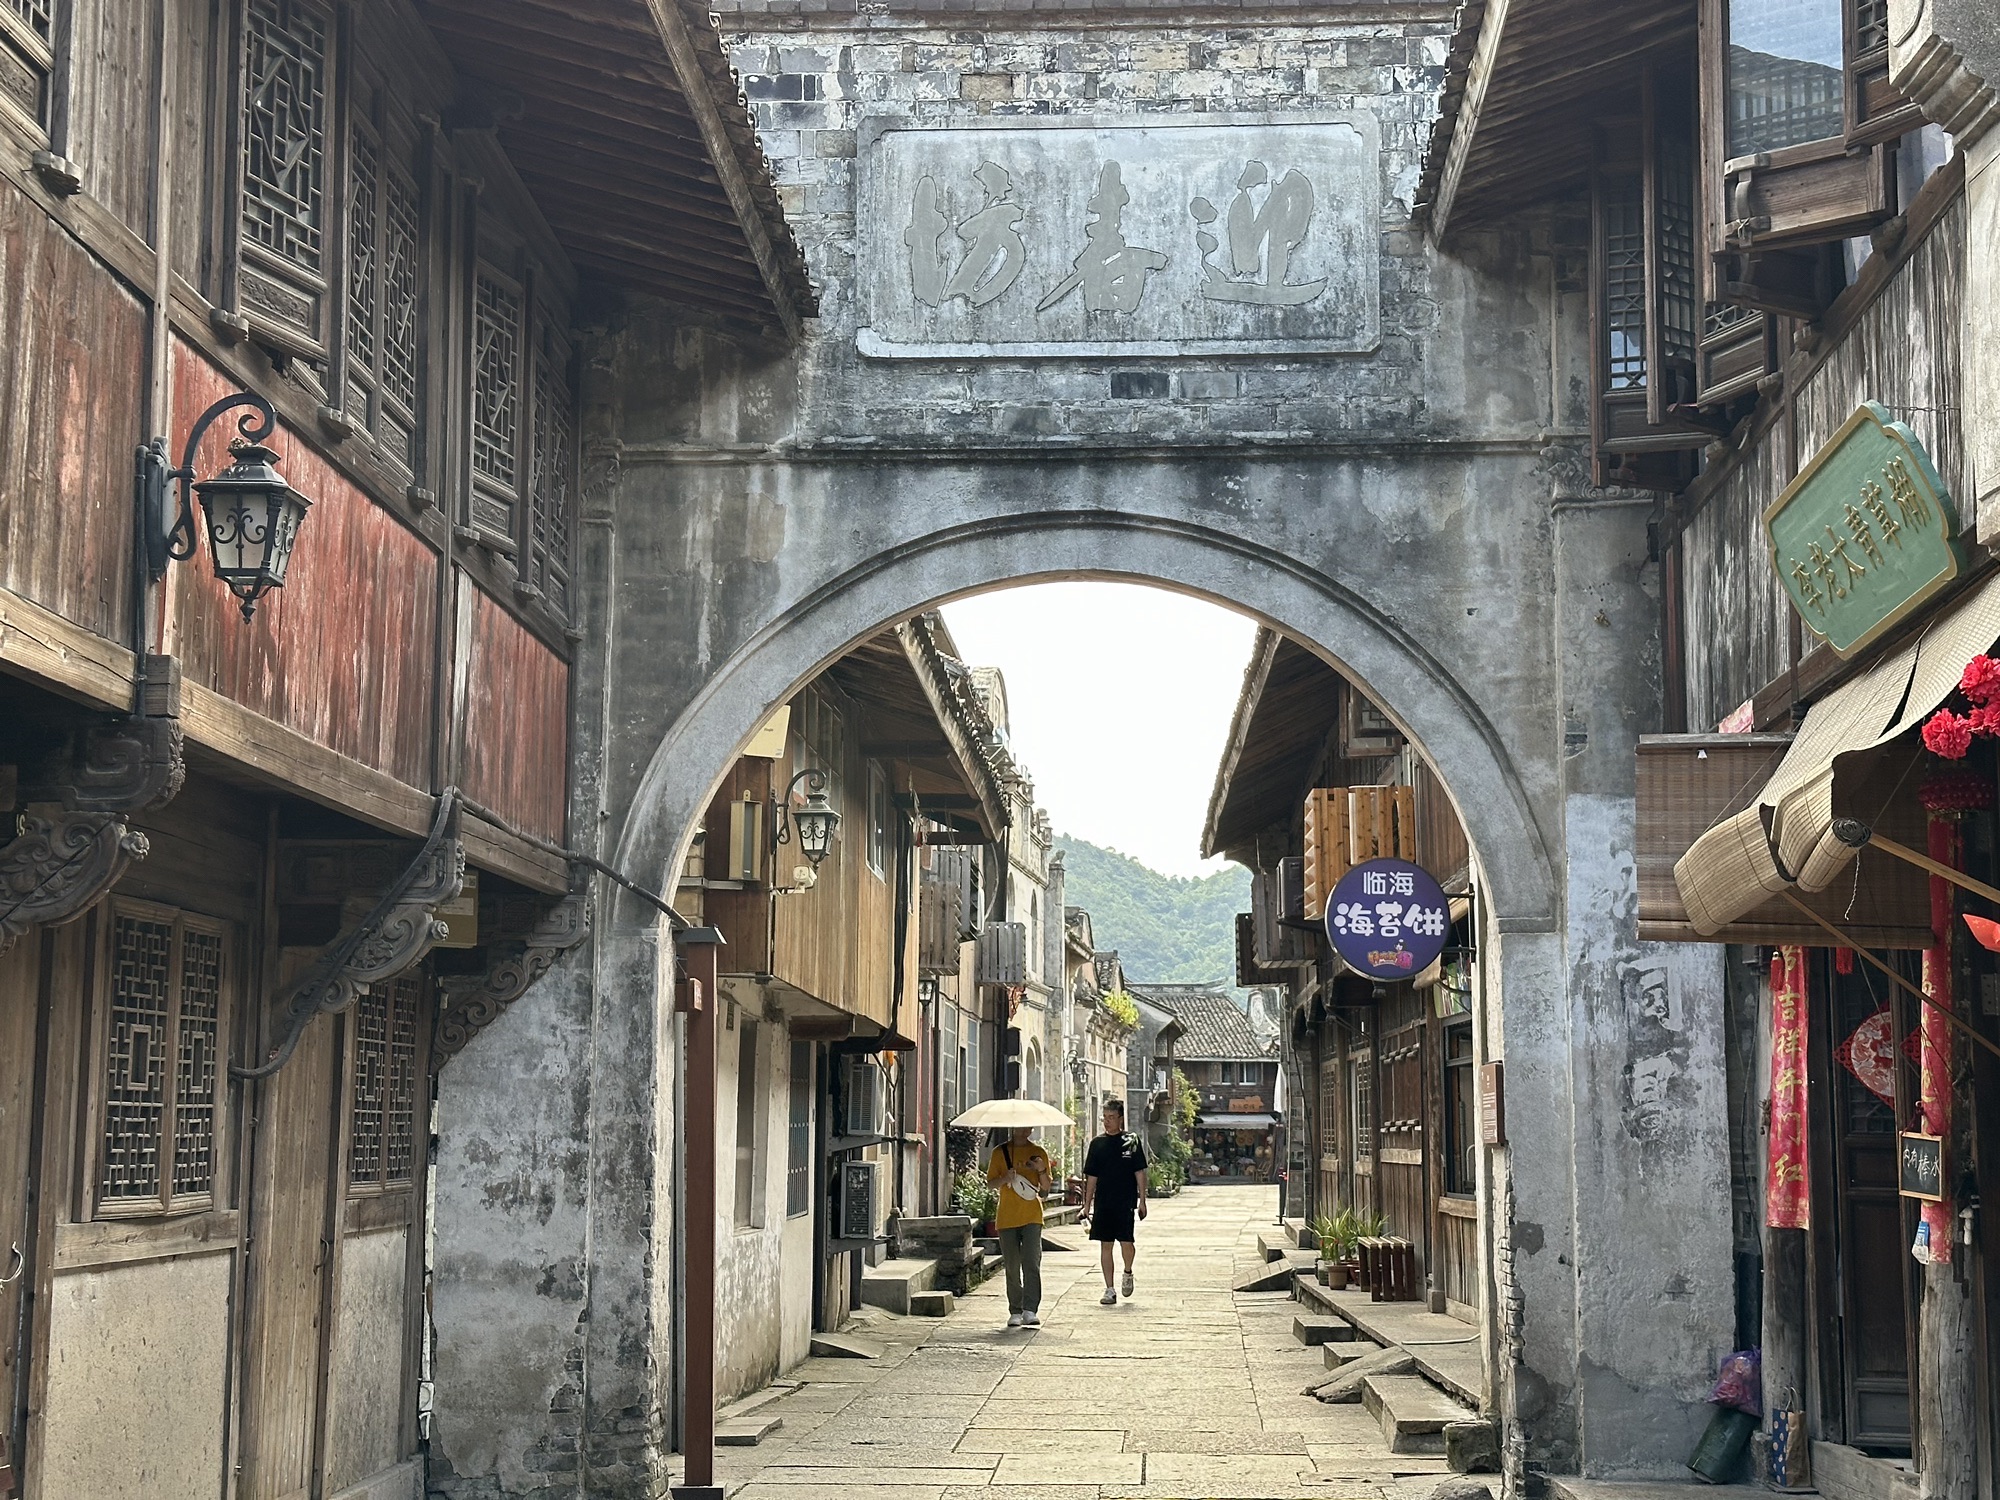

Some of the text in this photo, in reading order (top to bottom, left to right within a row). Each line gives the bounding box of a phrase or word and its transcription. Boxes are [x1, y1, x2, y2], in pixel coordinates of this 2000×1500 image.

[1363, 871, 1414, 896] 临海
[1333, 901, 1445, 938] 海苔饼
